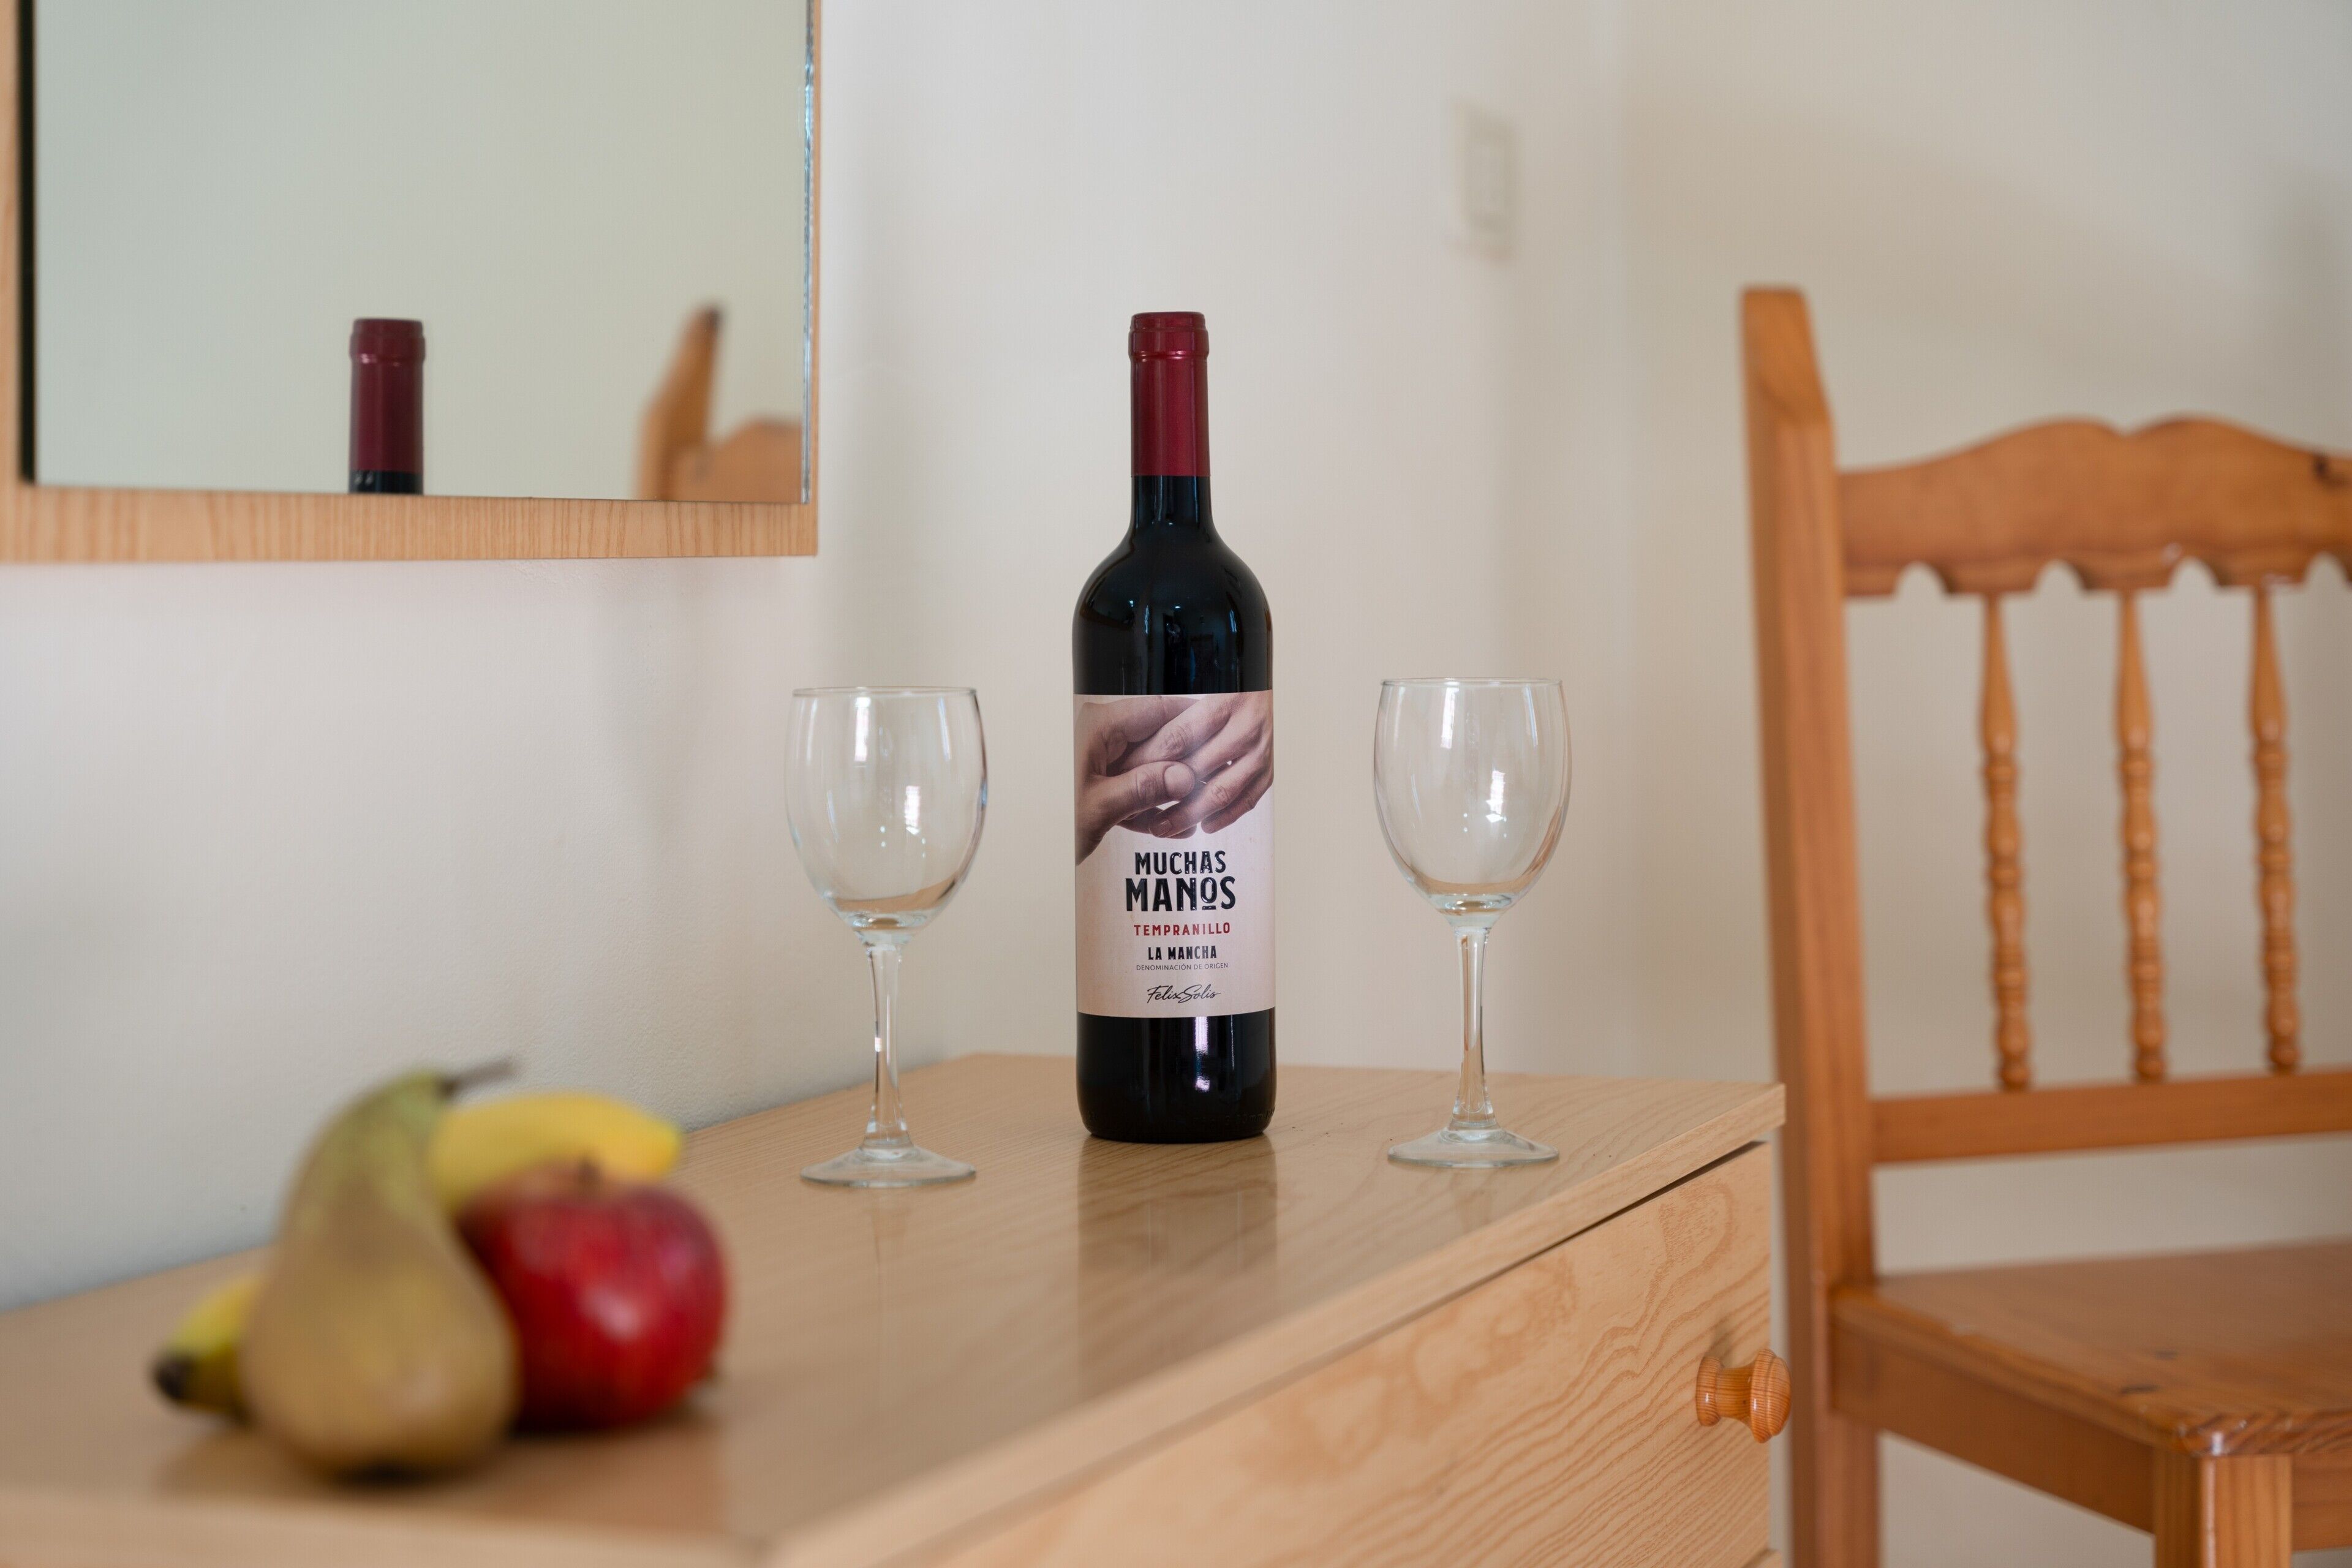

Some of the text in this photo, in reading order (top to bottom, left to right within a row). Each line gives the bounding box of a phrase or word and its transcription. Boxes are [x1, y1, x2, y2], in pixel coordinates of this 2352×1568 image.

[1135, 851, 1226, 875] MUCHAS
[1125, 876, 1236, 911] MANOS
[1134, 922, 1230, 936] TEMPRANILLO
[1148, 945, 1217, 960] LA MANCHA
